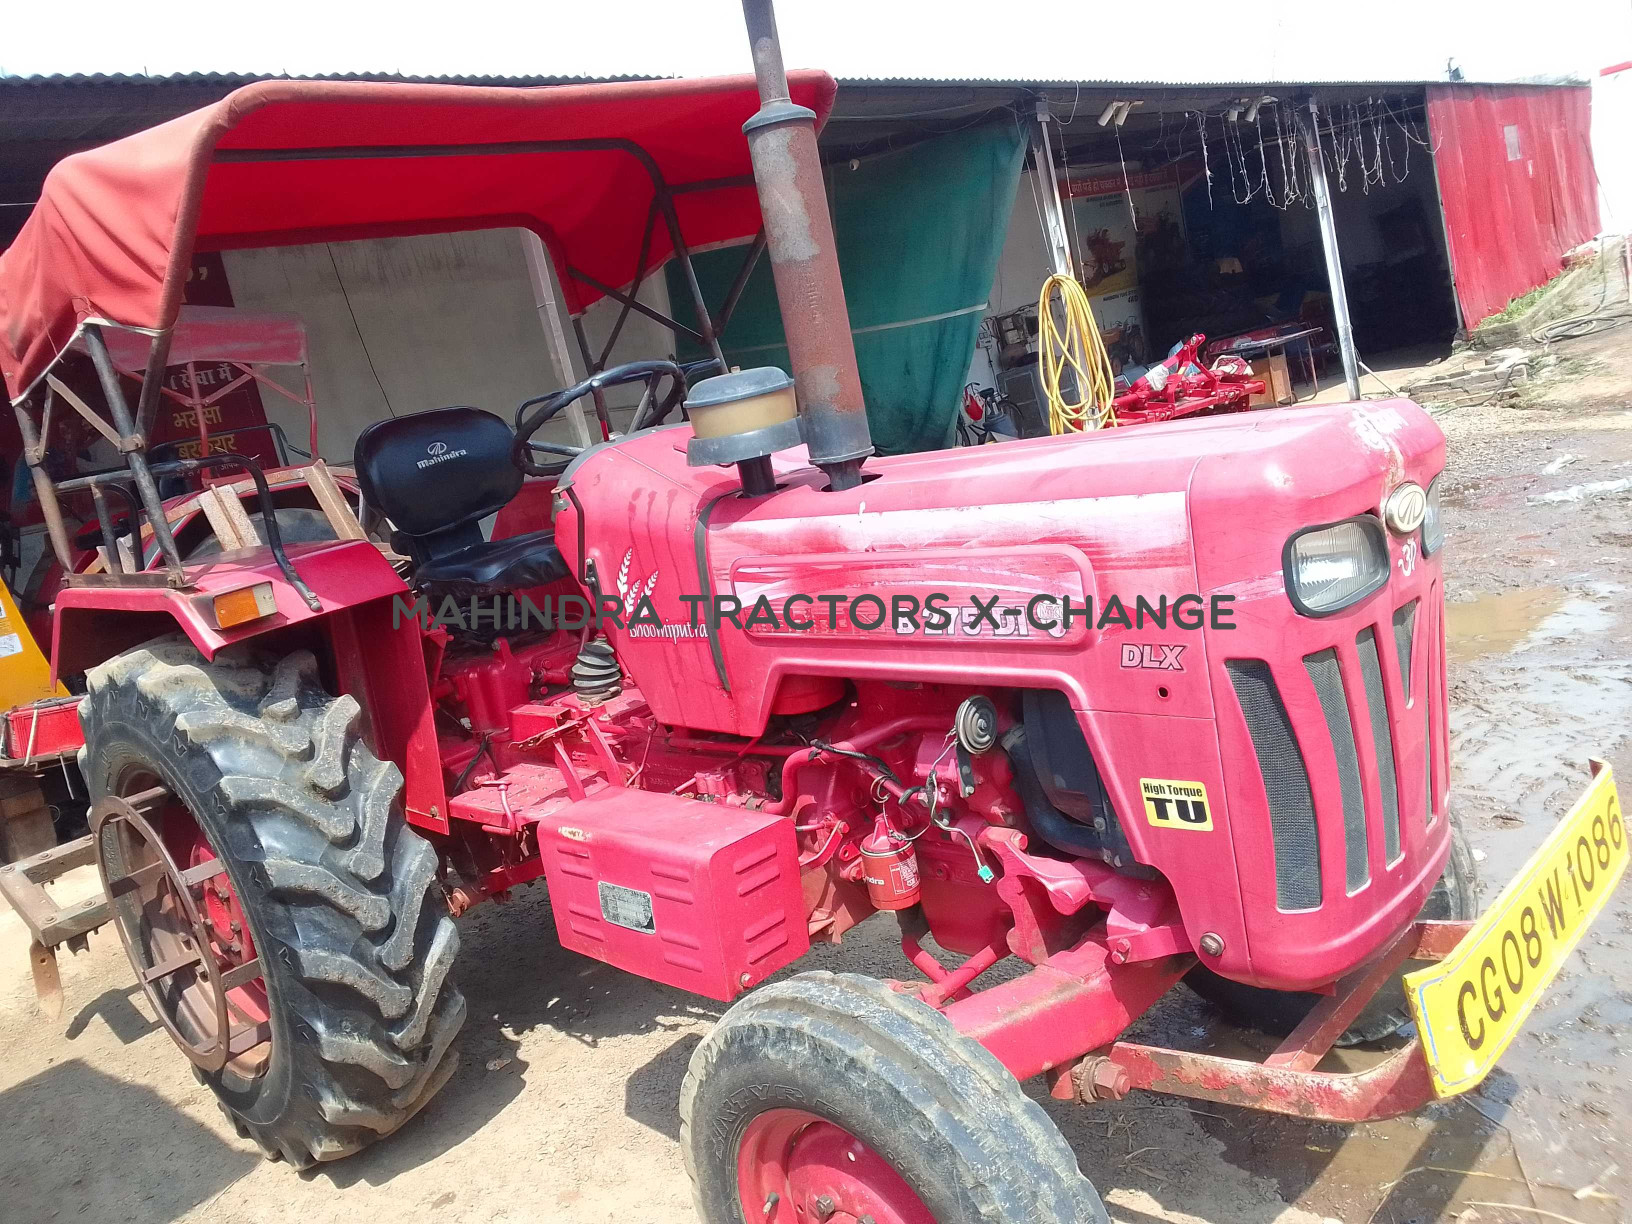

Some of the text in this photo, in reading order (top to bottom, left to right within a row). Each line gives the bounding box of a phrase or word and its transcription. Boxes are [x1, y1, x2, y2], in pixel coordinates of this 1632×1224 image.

[416, 449, 467, 469] Mahindra
[1121, 643, 1188, 671] DLX
[1143, 783, 1203, 798] High Torque
[1146, 796, 1208, 824] TU
